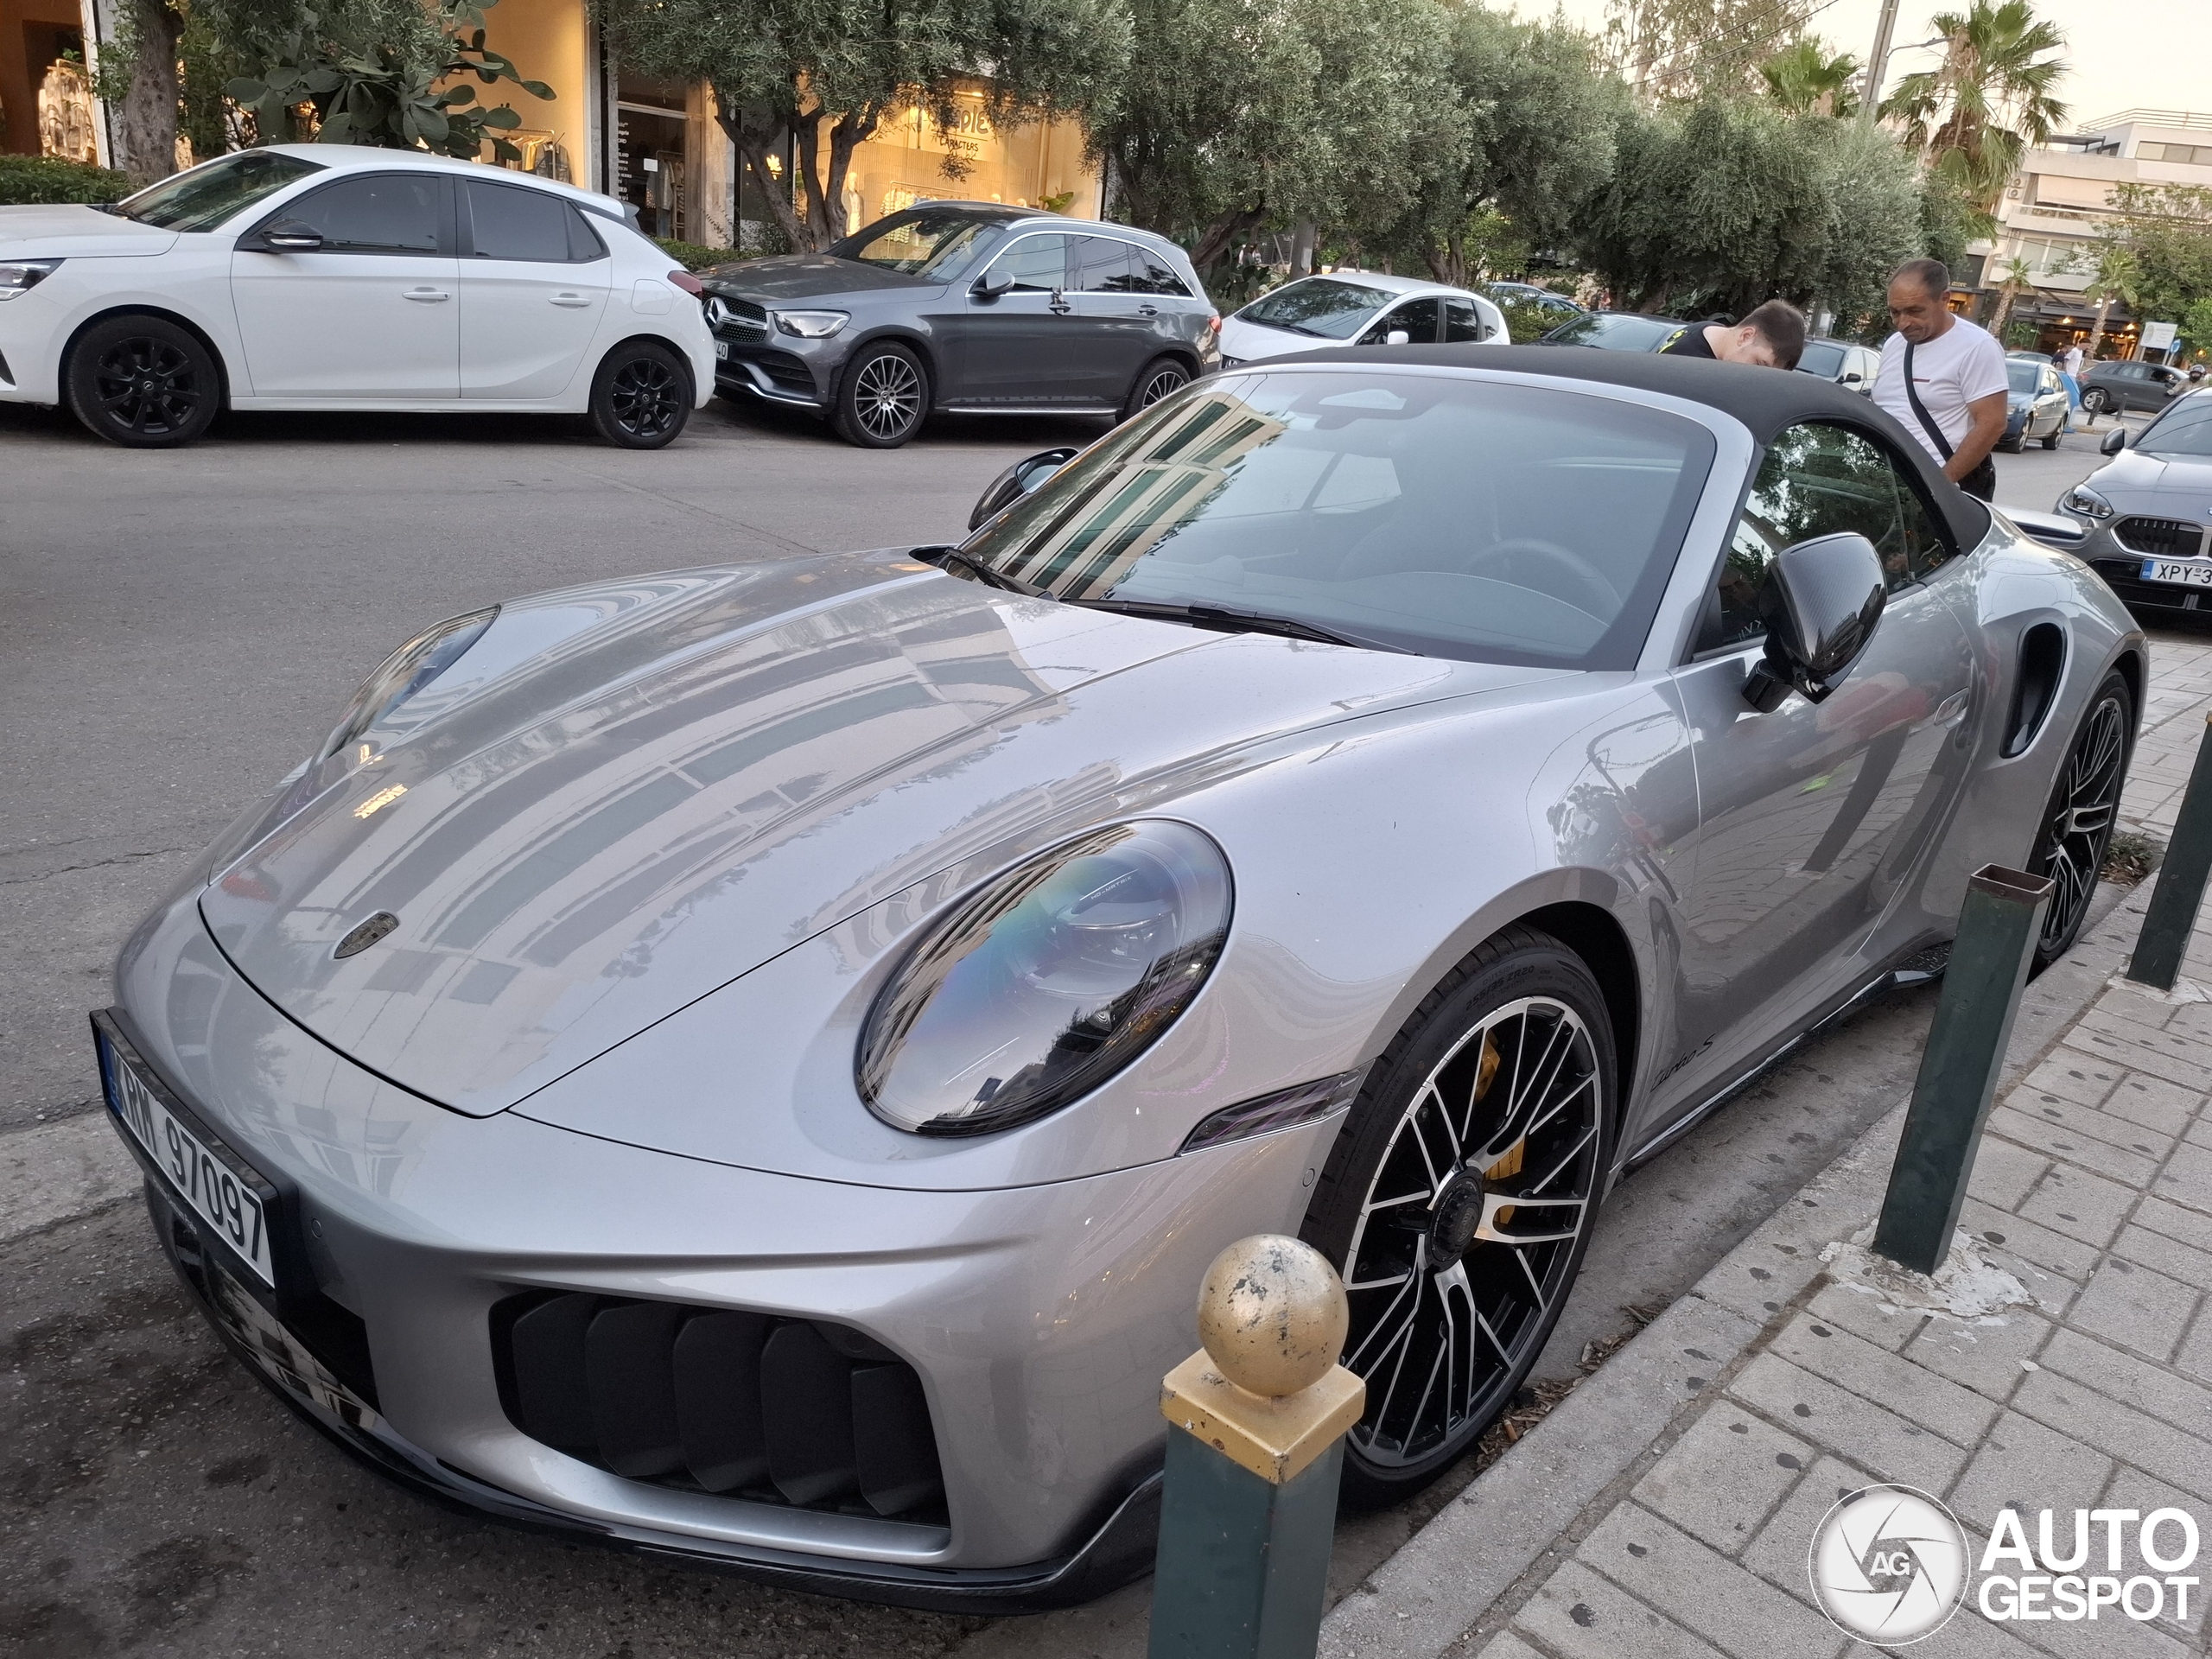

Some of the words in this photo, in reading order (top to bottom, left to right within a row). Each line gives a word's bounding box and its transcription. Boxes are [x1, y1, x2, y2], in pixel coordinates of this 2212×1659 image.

[716, 343, 727, 358] 40
[1091, 876, 1132, 899] HD-MATRIX
[1483, 963, 1516, 986] OUTSIDE
[1507, 965, 1535, 982] ZR20
[961, 1050, 1007, 1082] PORSCHE
[166, 1116, 262, 1263] 97097
